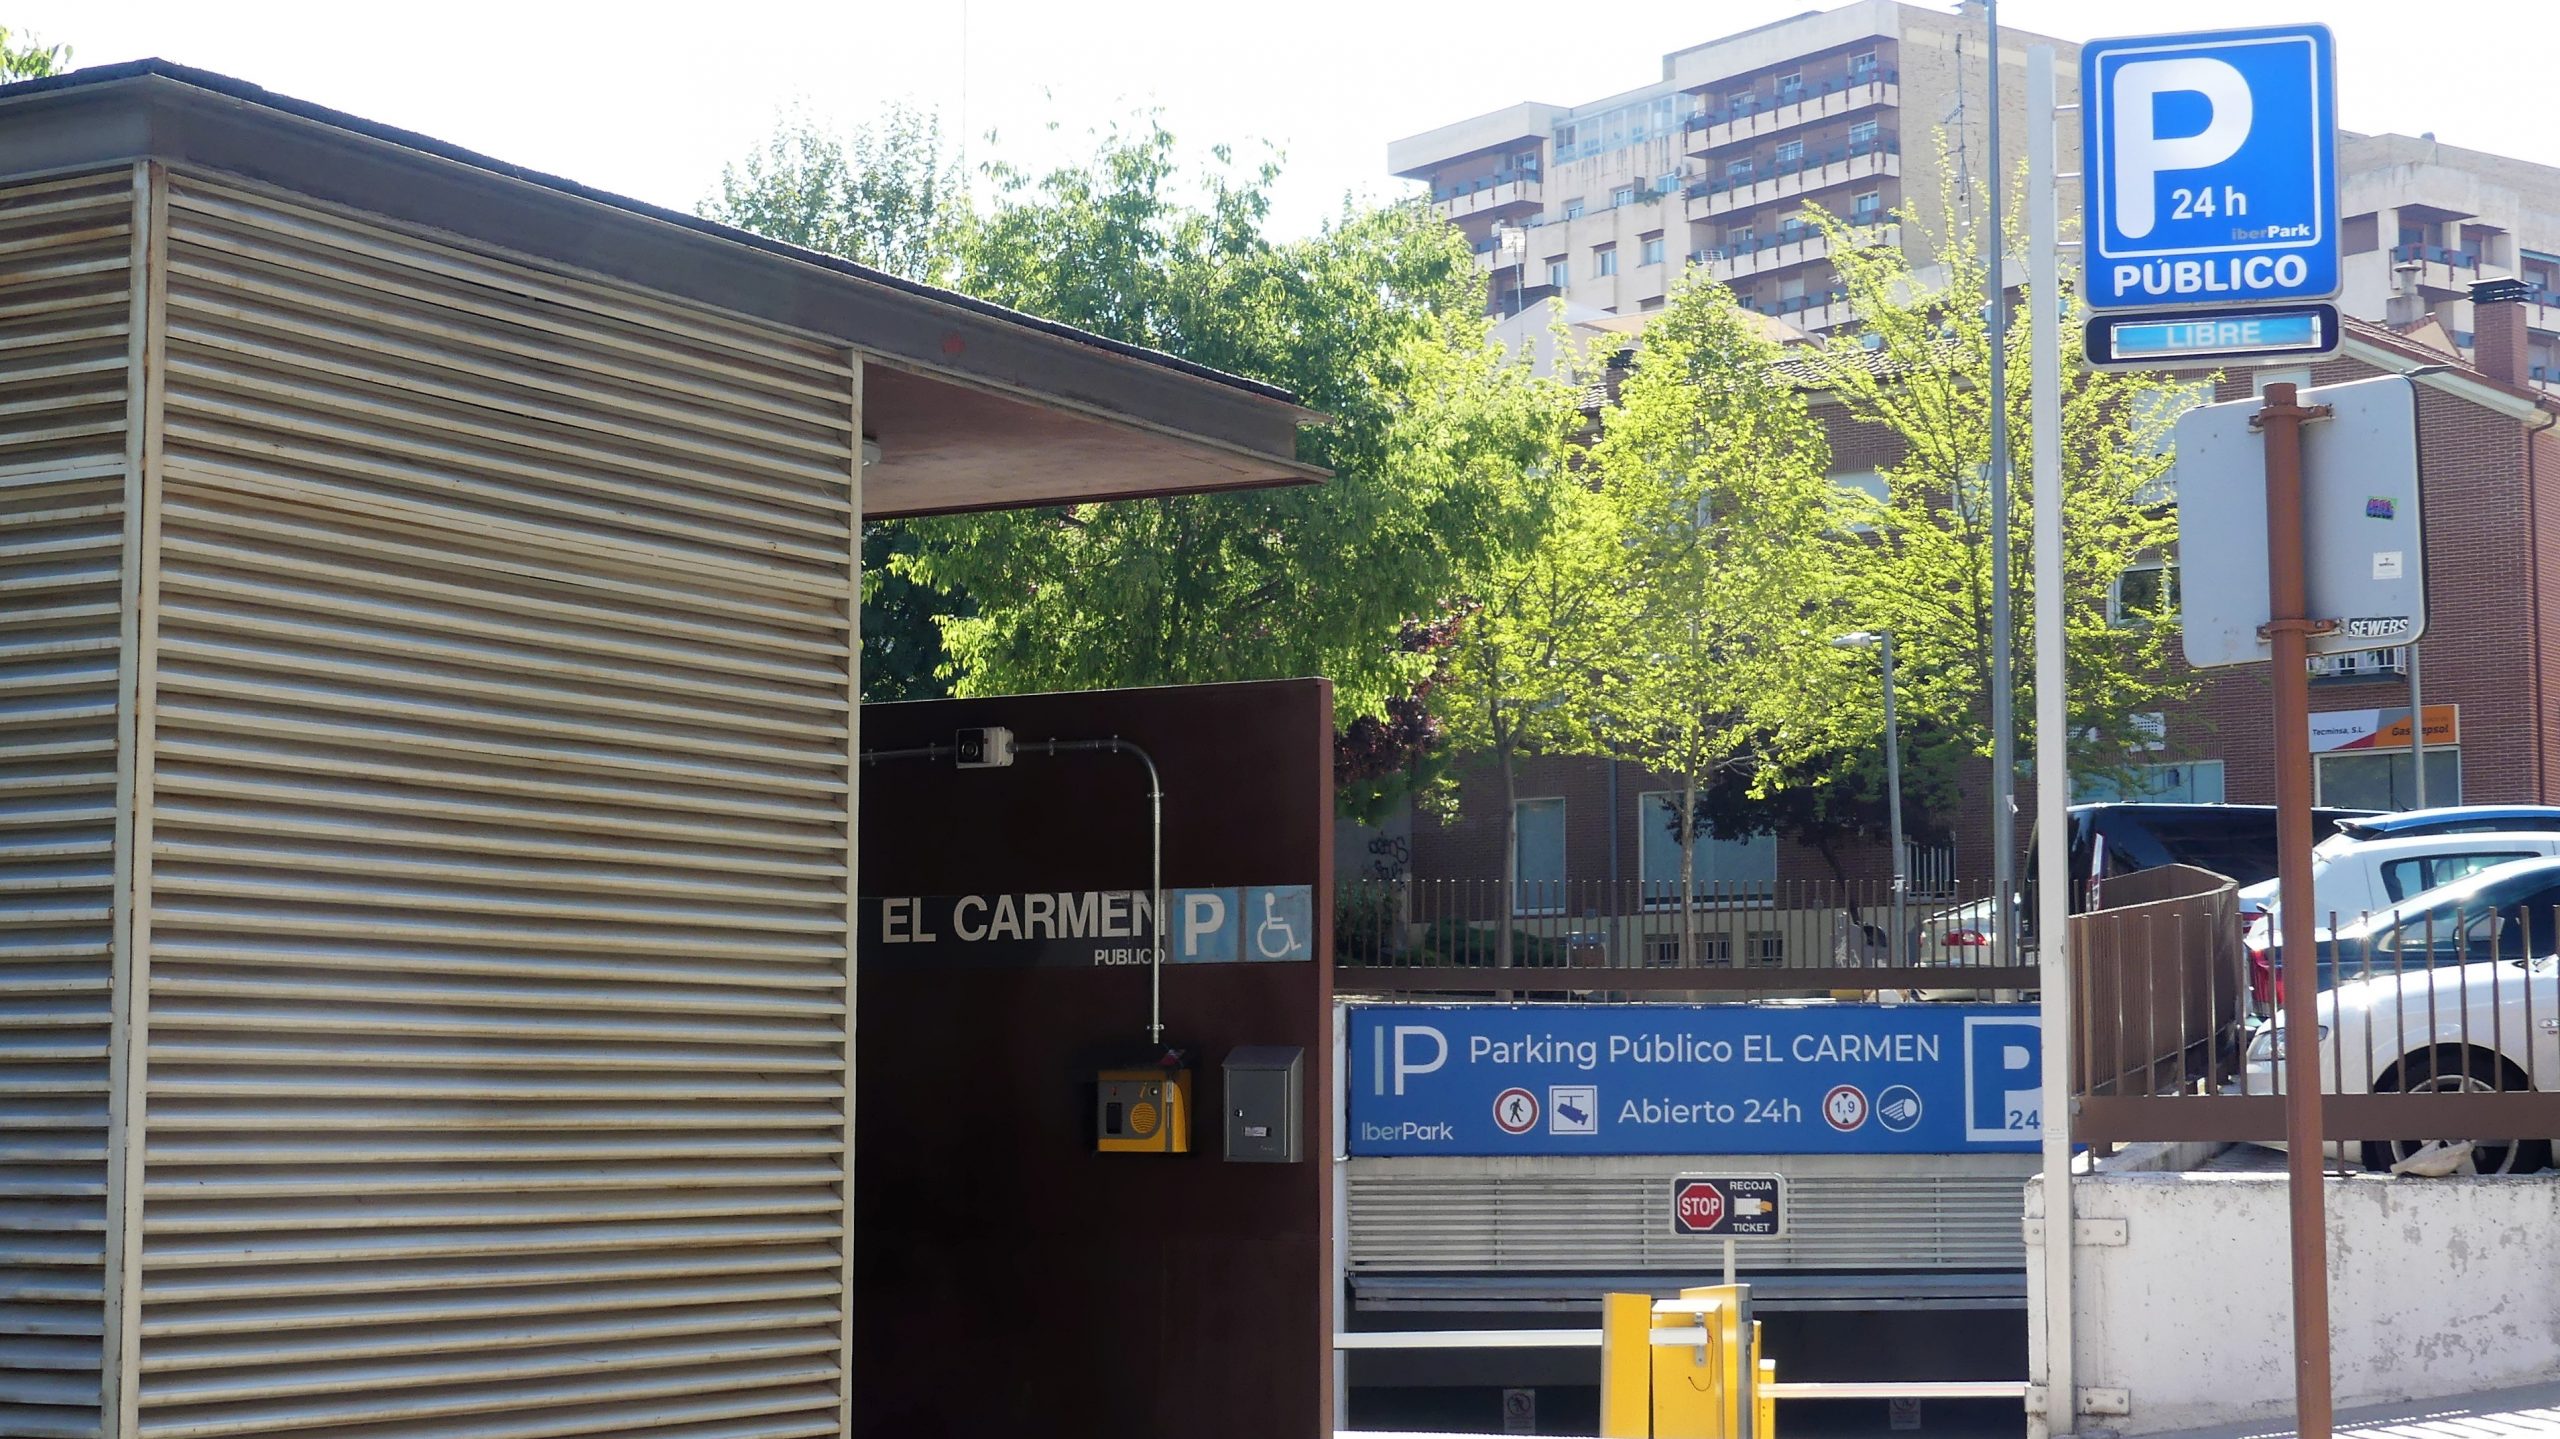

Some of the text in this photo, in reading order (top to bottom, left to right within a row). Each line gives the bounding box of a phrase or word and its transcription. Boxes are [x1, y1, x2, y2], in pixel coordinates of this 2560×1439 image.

[2113, 57, 2253, 239] P
[2171, 185, 2247, 220] 24 h
[2114, 254, 2308, 297] PÚBLICO
[2167, 322, 2262, 348] LIBRE
[2349, 618, 2409, 638] SEWERS
[2392, 727, 2410, 736] Gas
[882, 889, 1166, 943] EL CARMEN
[1185, 893, 1225, 956] P
[1470, 1033, 1939, 1070] Parking Público EL CARMEN
[1617, 1098, 1801, 1124] Abierto 24h
[1834, 1101, 1856, 1115] 1,9
[1362, 1122, 1454, 1141] IberPark
[1729, 1181, 1772, 1190] RECOJA
[1681, 1197, 1720, 1216] STOP
[1733, 1223, 1770, 1232] TICKET
